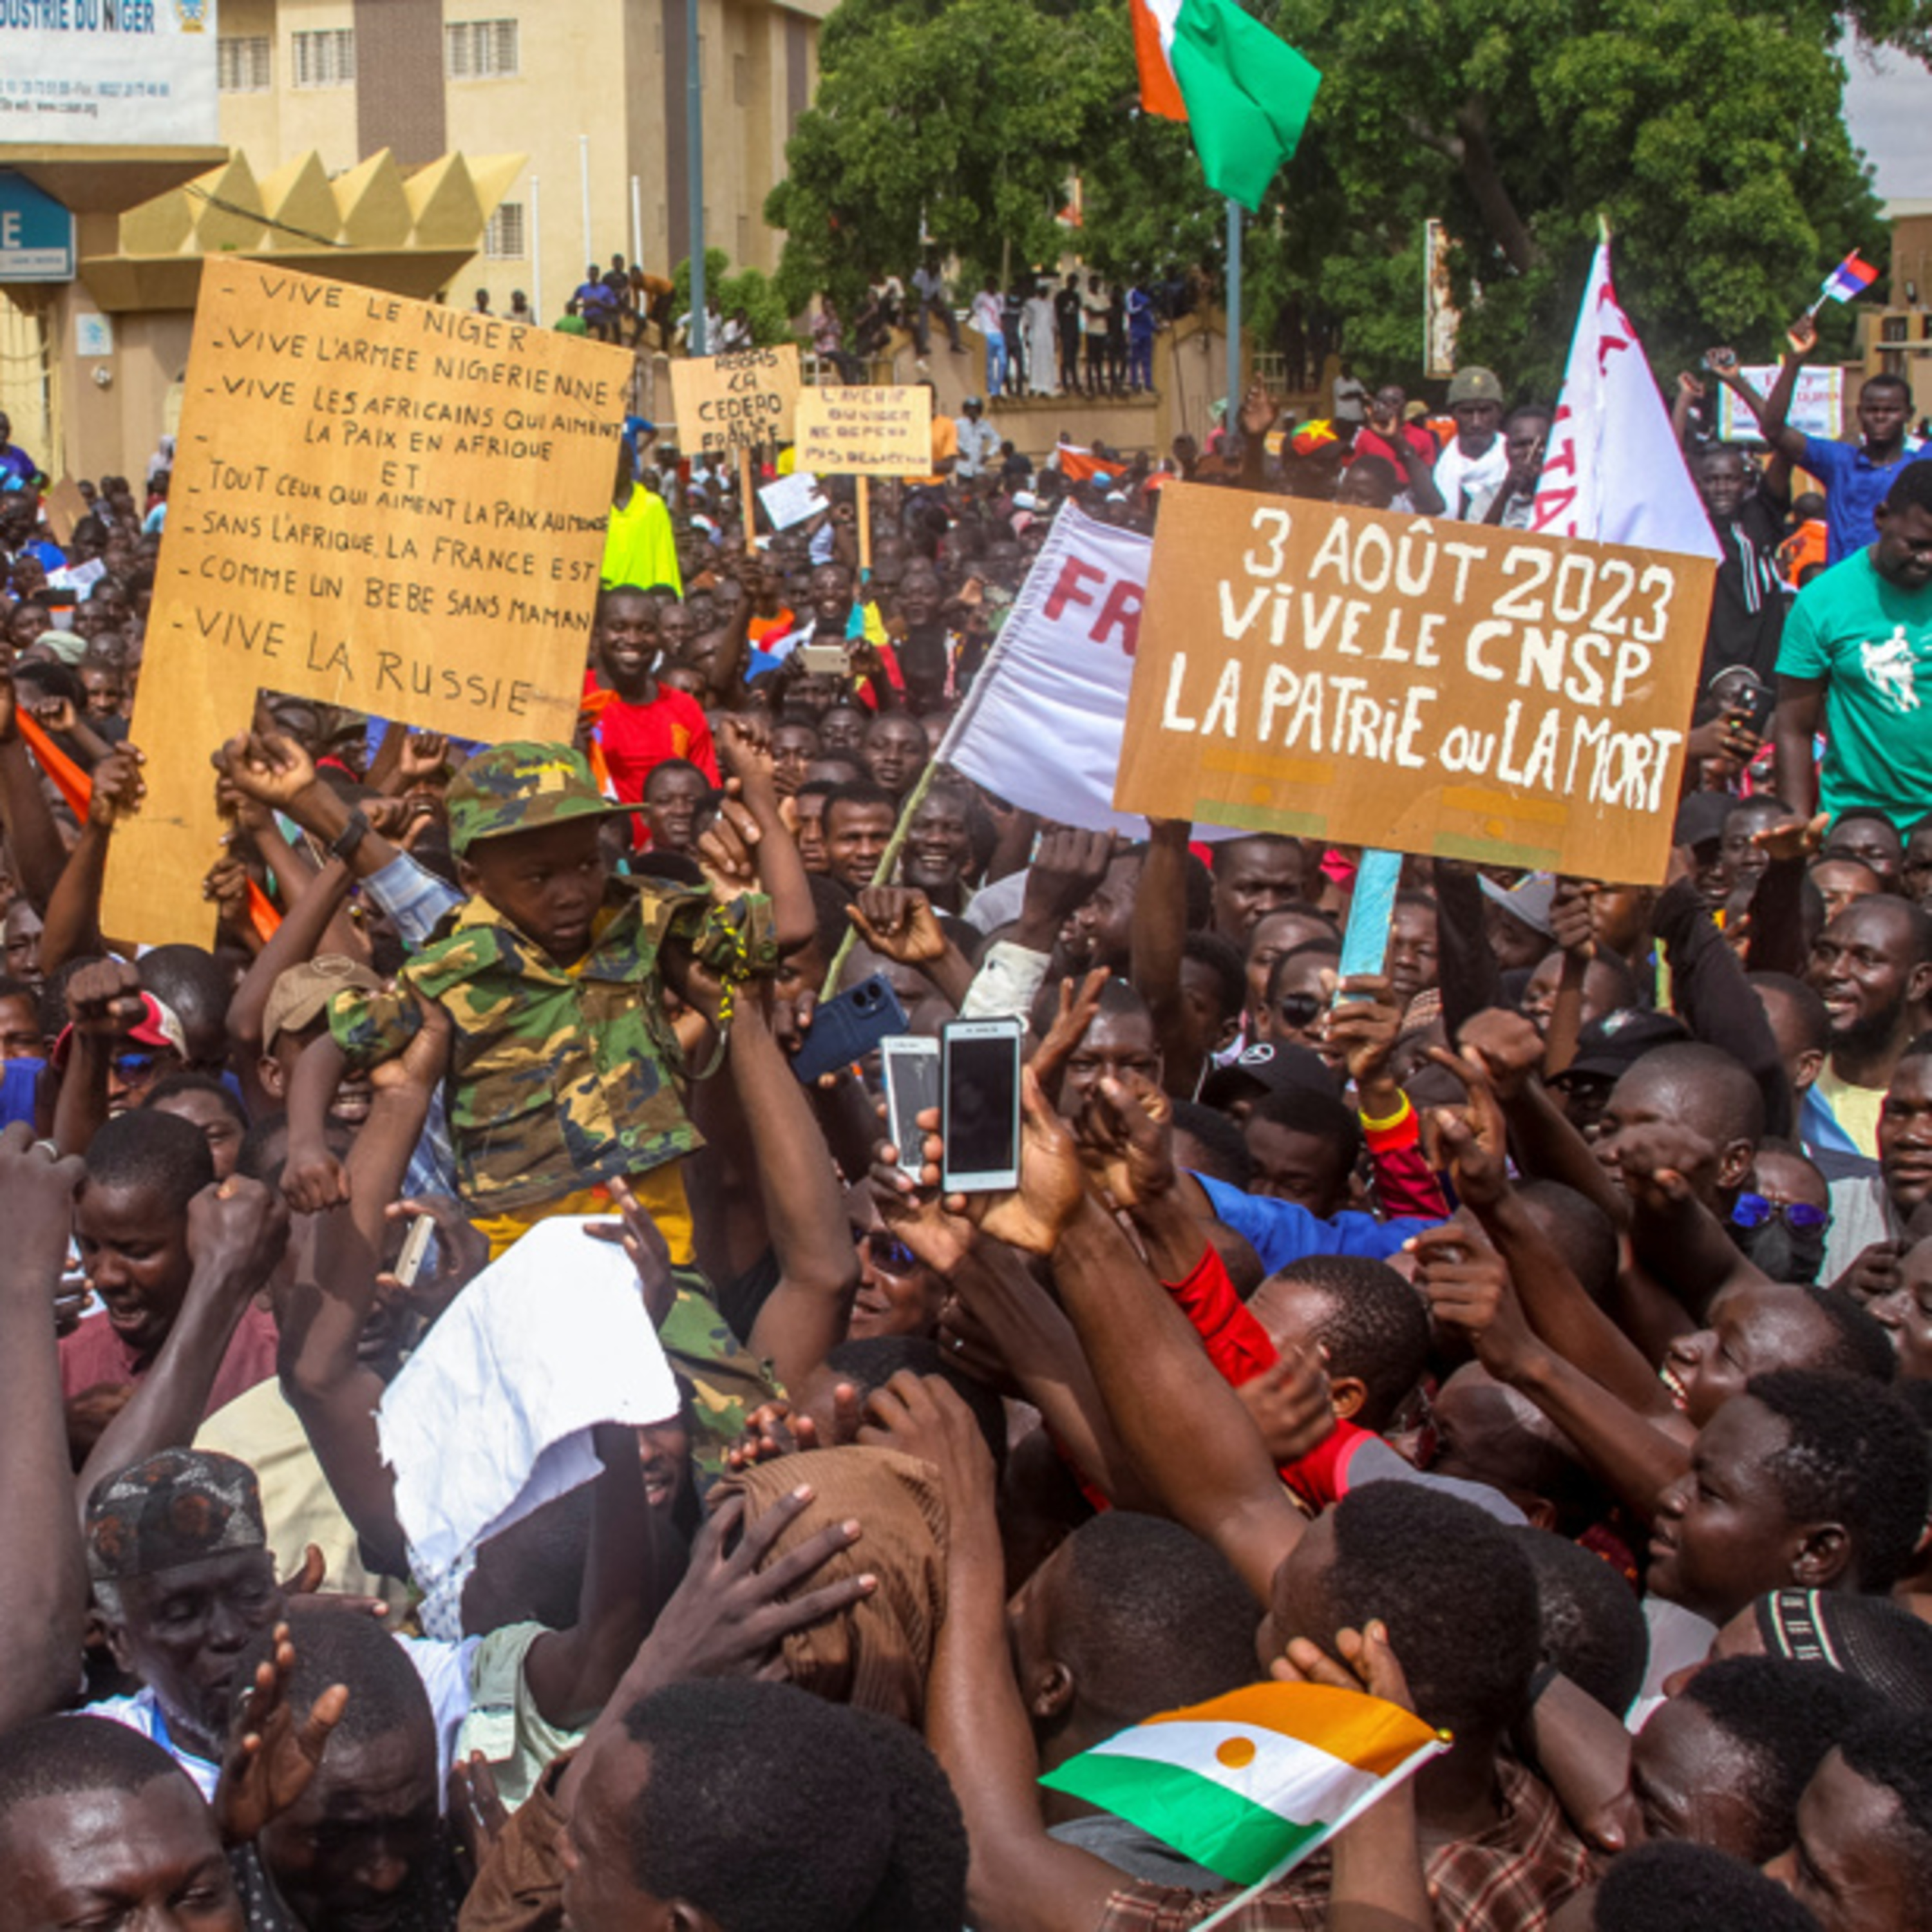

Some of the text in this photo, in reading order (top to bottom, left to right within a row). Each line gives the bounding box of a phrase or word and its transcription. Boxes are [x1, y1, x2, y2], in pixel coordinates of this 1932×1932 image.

[75, 0, 97, 31] DU
[103, 0, 155, 32] NIGER
[260, 276, 343, 308] VIVE
[366, 297, 401, 322] LE
[423, 310, 527, 352] NIGER
[228, 327, 307, 357] VIVE
[317, 335, 419, 371] L'ARMEE
[435, 357, 608, 406] NIGERIENNE
[222, 375, 296, 405] VIVE
[314, 386, 359, 415] LES
[363, 397, 494, 428] AFRICAINS
[552, 415, 622, 440] AIMENT
[304, 420, 553, 461] LA PAIX EN AFRIQUE
[210, 459, 269, 493] TOUT
[275, 474, 321, 500] CEUX
[329, 485, 368, 505] QUI
[375, 491, 455, 520] AIMENT
[464, 502, 488, 525] LA
[494, 500, 540, 531] PAIX
[381, 460, 420, 489] ET
[202, 511, 261, 538] SANS
[386, 534, 418, 560] LA
[432, 536, 535, 576] FRANCE
[551, 557, 596, 582] EST
[1243, 507, 1675, 643] 3 AOÛT 2023
[200, 554, 298, 595] COMME
[310, 573, 343, 599] UN
[365, 577, 435, 614] BEBE
[447, 589, 500, 618] SANS
[508, 599, 591, 632] MAMAN
[195, 607, 285, 658] VIVE
[307, 630, 355, 682] LA
[377, 650, 533, 716] RUSSIE
[1379, 607, 1446, 667] LE
[1465, 620, 1652, 706] CNSP
[1162, 652, 1241, 738] LA
[1497, 698, 1560, 792] LA
[1564, 715, 1682, 813] MORT
